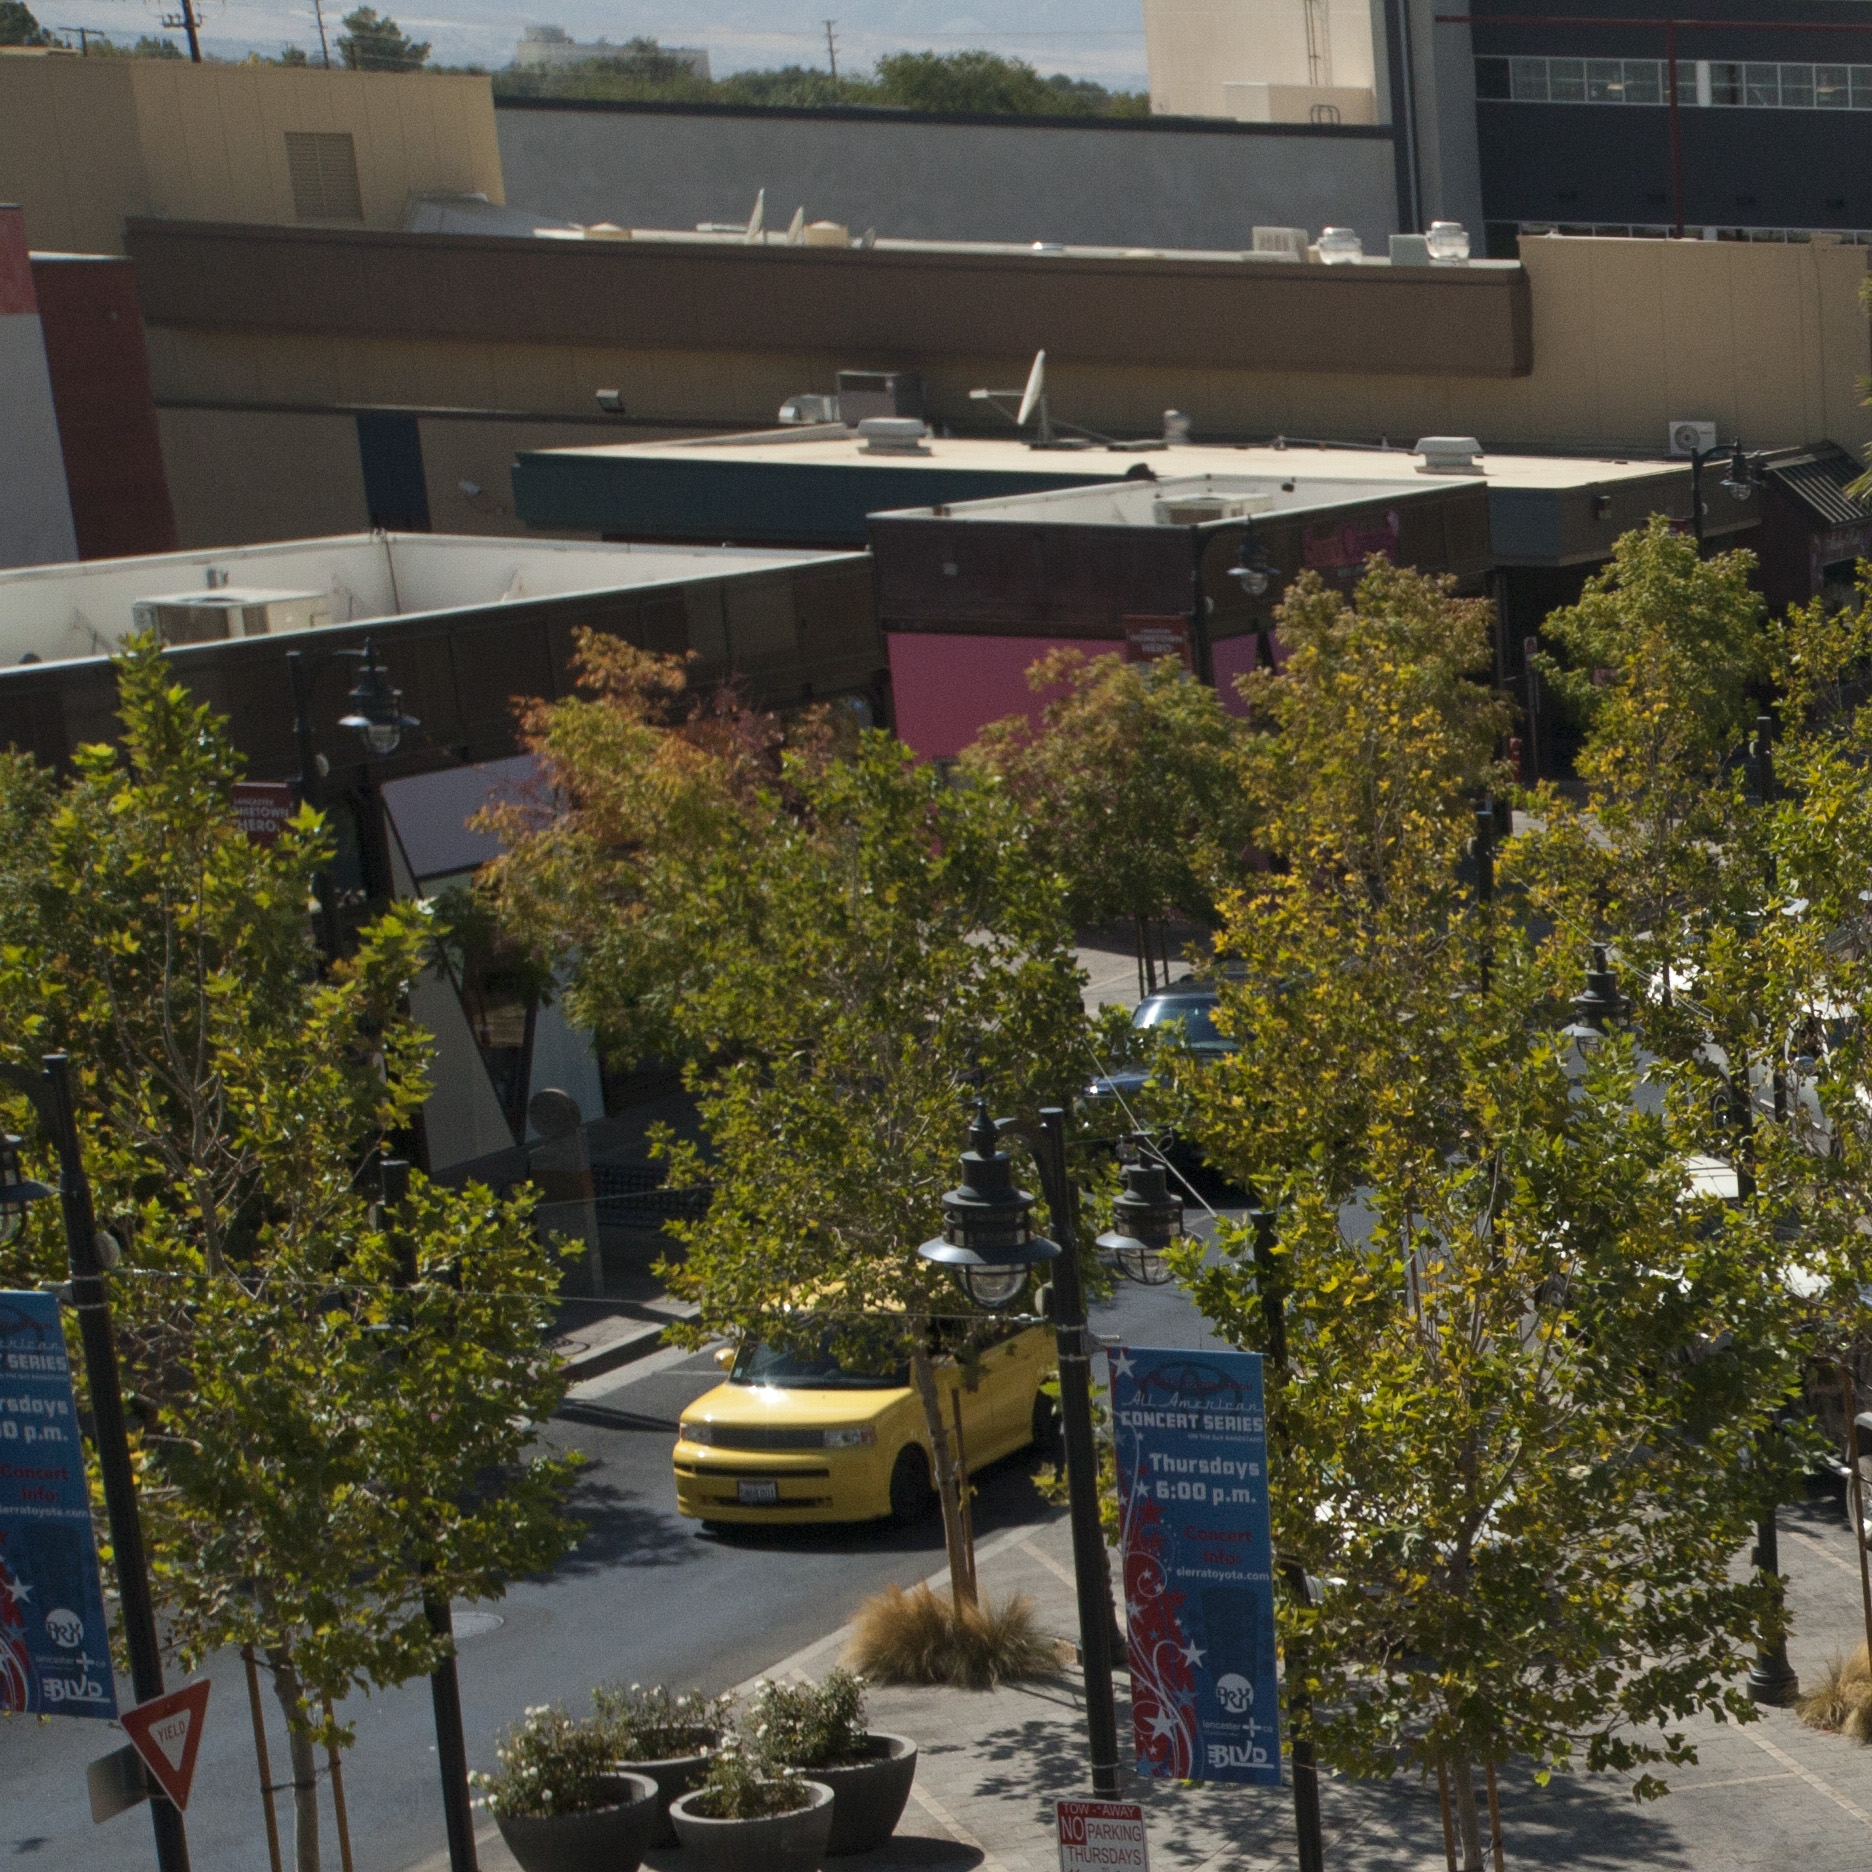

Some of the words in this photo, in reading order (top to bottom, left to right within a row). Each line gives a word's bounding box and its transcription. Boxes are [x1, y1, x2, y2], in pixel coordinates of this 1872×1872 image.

[7, 1353, 68, 1371] SERIES
[1158, 1391, 1263, 1412] American
[1121, 1410, 1199, 1430] CONCERT
[1204, 1415, 1263, 1433] SERIES
[24, 1424, 69, 1443] p.m.
[1149, 1452, 1260, 1480] Thursdays
[1156, 1481, 1206, 1501] 6:00
[1212, 1487, 1257, 1507] p.m.
[1184, 1525, 1252, 1543] Concert
[1176, 1566, 1270, 1582] sierratoyota.com
[156, 1719, 186, 1744] YIELD
[1062, 1802, 1089, 1815] TOW
[1102, 1805, 1136, 1818] AWAY
[1061, 1815, 1085, 1841] NO
[1087, 1823, 1142, 1842] PARKING
[1067, 1846, 1142, 1866] THURSDAYS
